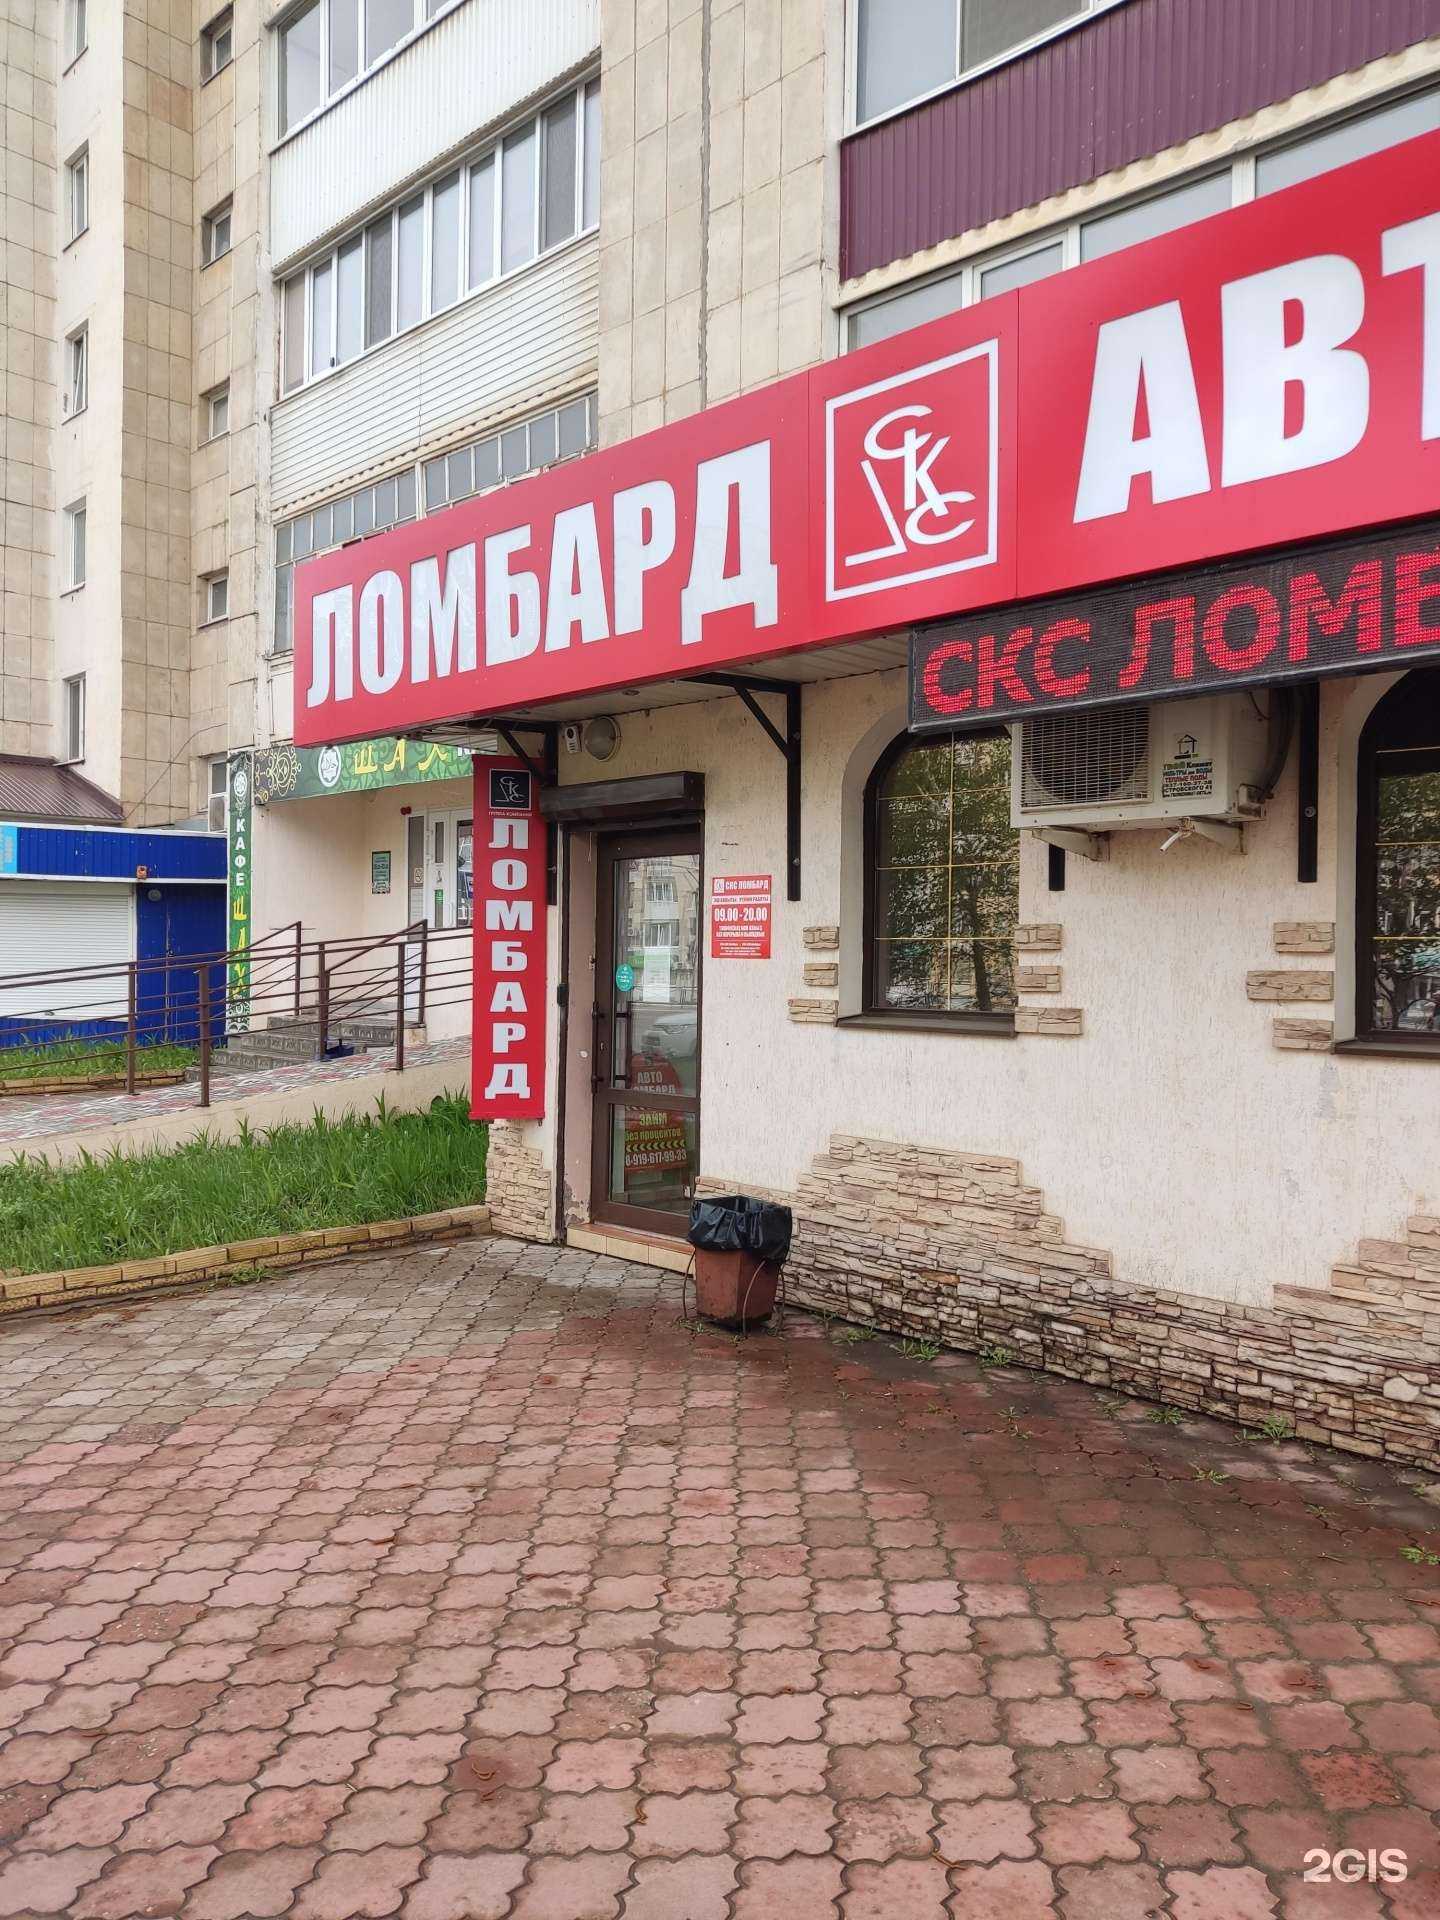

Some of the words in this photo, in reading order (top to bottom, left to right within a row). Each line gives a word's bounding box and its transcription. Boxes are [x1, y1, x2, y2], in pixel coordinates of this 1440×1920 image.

[306, 439, 778, 708] ЛОМБАРД
[922, 617, 1091, 714] СКС
[234, 818, 246, 887] КАФЕ
[484, 818, 533, 1099] ЛОМБАРД
[637, 1071, 663, 1084] АВТО
